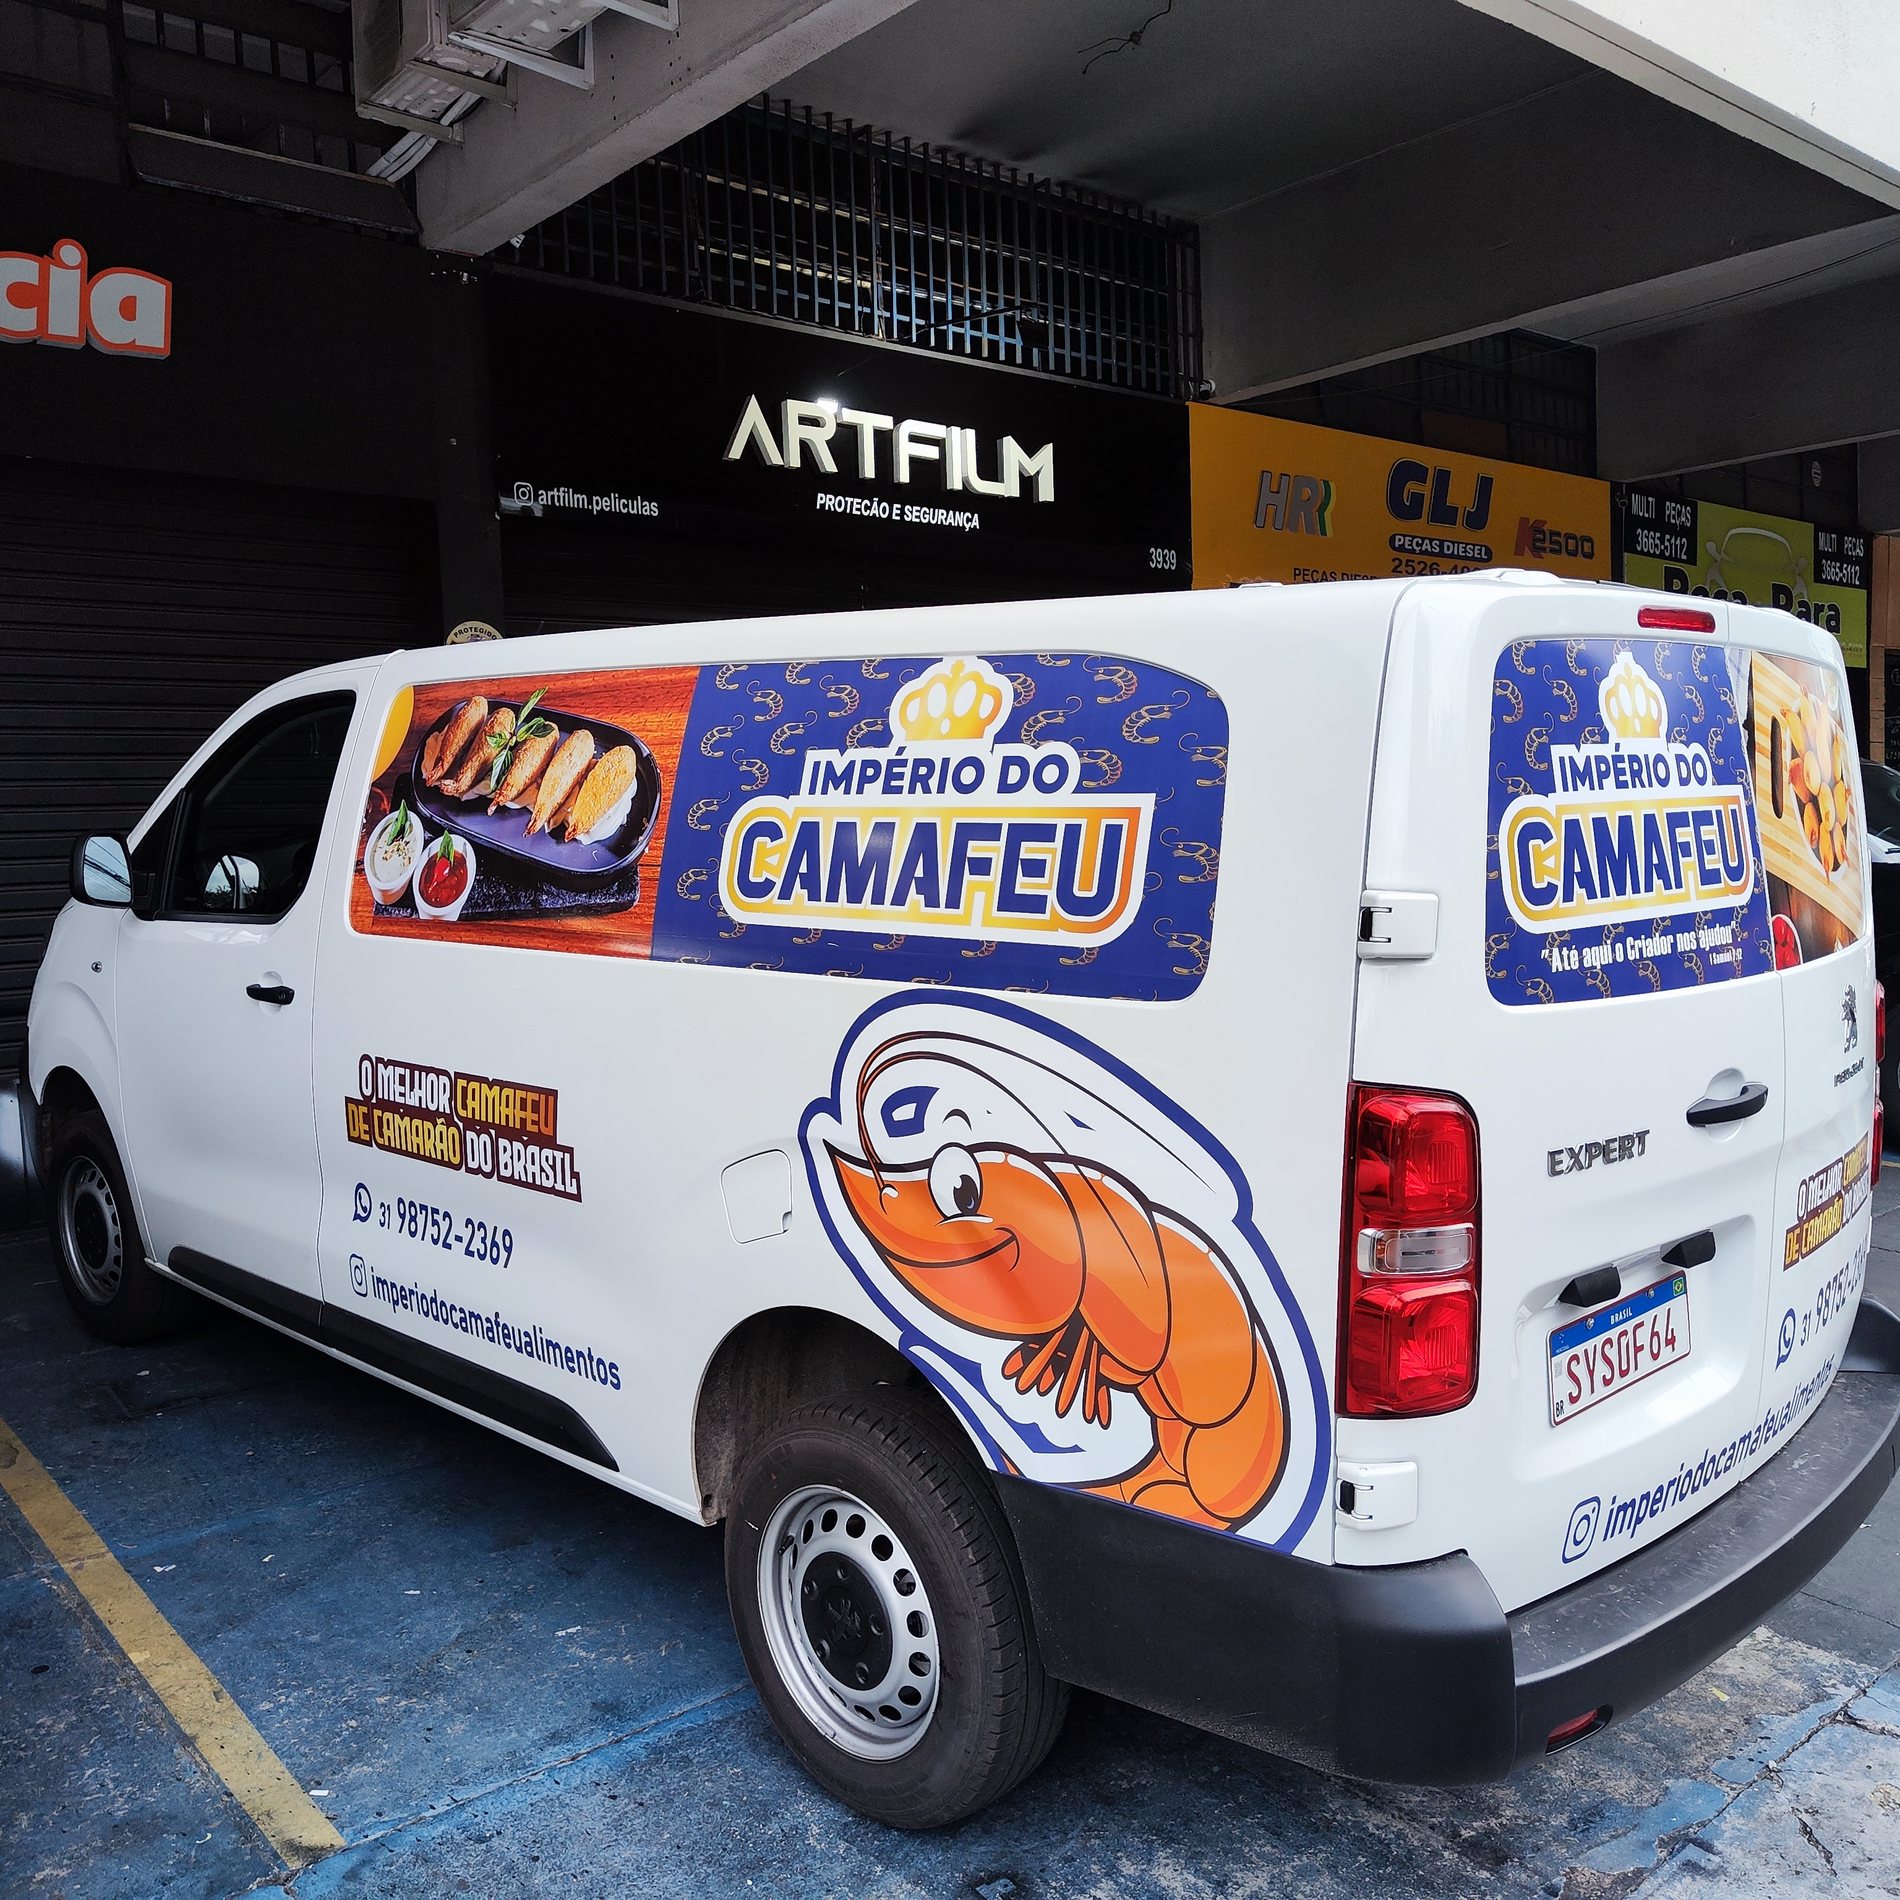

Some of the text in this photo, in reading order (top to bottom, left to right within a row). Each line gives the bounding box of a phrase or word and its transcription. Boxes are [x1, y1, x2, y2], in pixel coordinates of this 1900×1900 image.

[0, 238, 172, 360] cia
[722, 394, 1055, 503] ARTFILM
[537, 486, 659, 517] artfilm.peliculas
[892, 503, 901, 520] E
[903, 504, 980, 532] SEGURANÇA
[1387, 457, 1495, 532] GLJ
[1631, 493, 1692, 530] MULTI PEÇAS
[1149, 547, 1178, 571] 3939
[1395, 534, 1488, 560] PEÇAS DIESEL
[1514, 517, 1595, 560] K2500
[1636, 528, 1688, 560] 3665-5112
[1818, 531, 1864, 560] MULTI PEÇAS
[1821, 559, 1860, 585] 3665-5112
[453, 626, 498, 640] PROTEGIDO
[808, 747, 1070, 796] IMPÉRIO DO
[1559, 743, 1708, 793] IMPÉRIO DO
[736, 821, 1125, 918] CAMAFEU
[1517, 807, 1745, 908] CAMAFEU
[1582, 939, 1613, 970] aqui
[1614, 941, 1624, 962] o
[1626, 934, 1674, 962] Criador
[1676, 930, 1697, 953] nos
[361, 1059, 556, 1137] O MELHOR CAMAFEU
[347, 1102, 578, 1196] DE CAMARÃO DO BRASIL
[1547, 1129, 1651, 1178] EXPERT
[1797, 1182, 1807, 1219] O
[1807, 1161, 1843, 1213] MELHOR
[378, 1196, 514, 1269] 31 98752-2369
[1785, 1226, 1800, 1266] DE
[1801, 1195, 1843, 1254] CAMARÃO
[371, 1266, 622, 1391] imperiodocamafeualimentos
[1610, 1306, 1633, 1326] BRASIL
[1800, 1309, 1812, 1347] 31
[1555, 1399, 1565, 1418] BR
